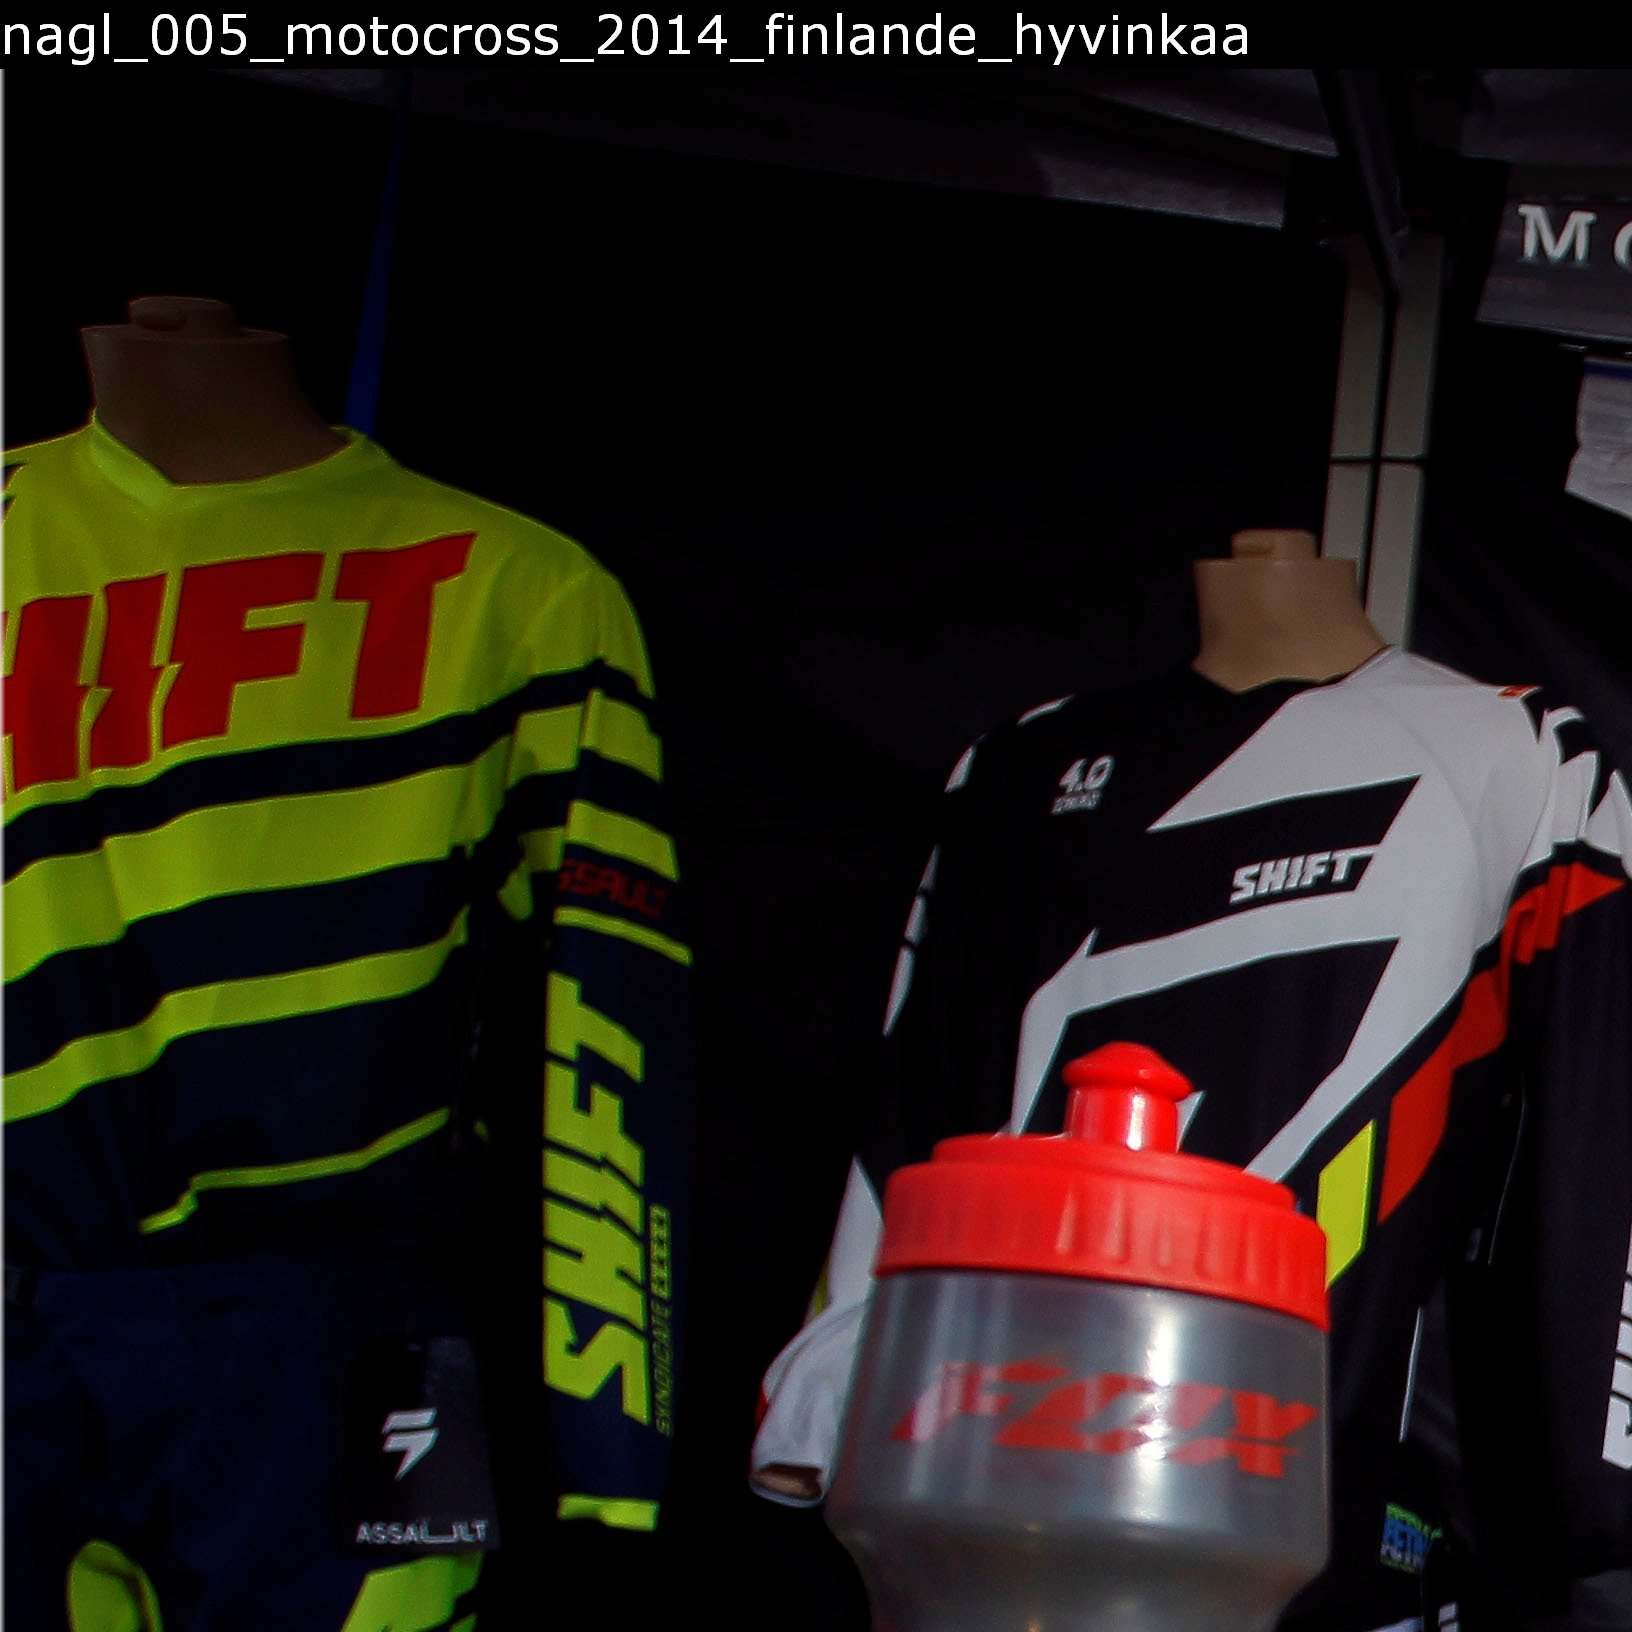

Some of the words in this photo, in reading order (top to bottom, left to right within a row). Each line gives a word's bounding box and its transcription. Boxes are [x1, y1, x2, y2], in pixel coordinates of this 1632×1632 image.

[0, 530, 479, 794] HIFT
[1229, 845, 1383, 903] SHIFT
[542, 971, 648, 1425] SHIFT
